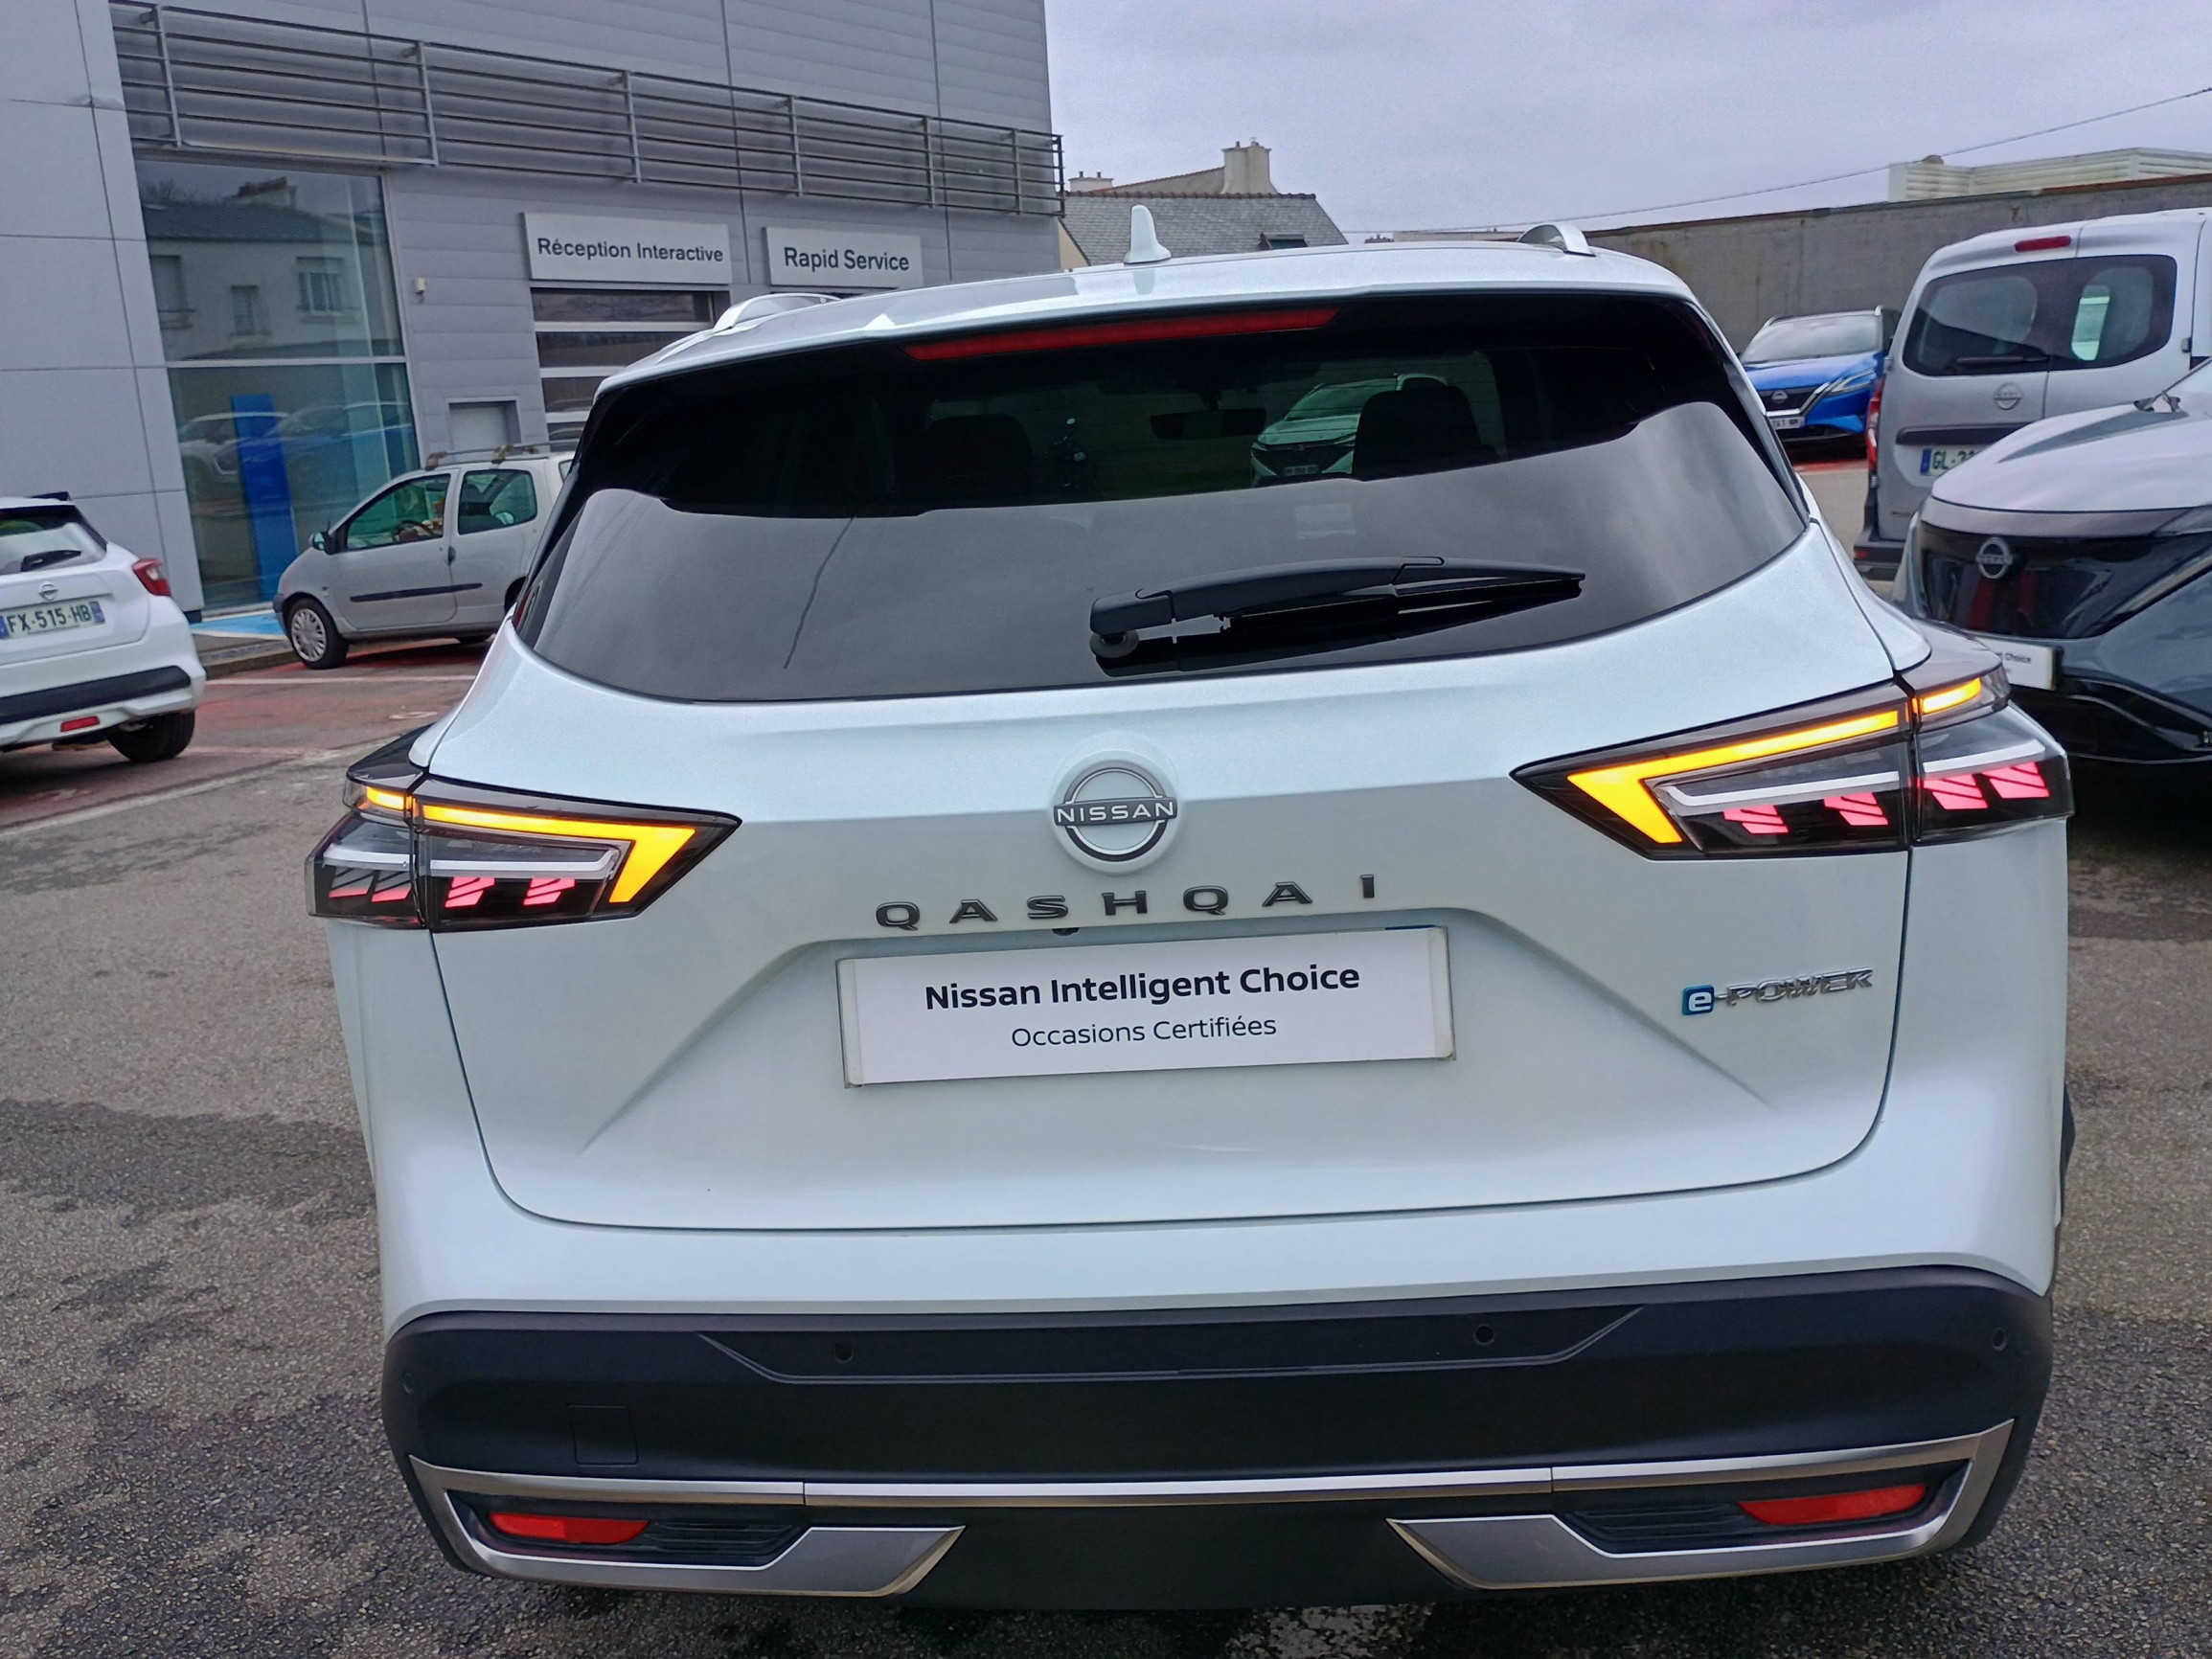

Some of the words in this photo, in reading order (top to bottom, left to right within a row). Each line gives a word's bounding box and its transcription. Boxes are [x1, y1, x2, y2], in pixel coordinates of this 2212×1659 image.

[536, 238, 631, 261] Réception
[636, 242, 723, 261] Interactive
[784, 246, 839, 272] Rapid
[844, 249, 909, 271] Service
[6, 604, 92, 633] FX-515-HB
[1057, 801, 1174, 823] NISSAN
[876, 874, 1376, 931] QASHQAI
[925, 981, 1041, 1010] Nissan
[1052, 970, 1231, 1006] Intelligent
[1240, 965, 1360, 994] Choice
[1012, 1022, 1146, 1047] Occasions
[1153, 1015, 1277, 1041] Certifiées
